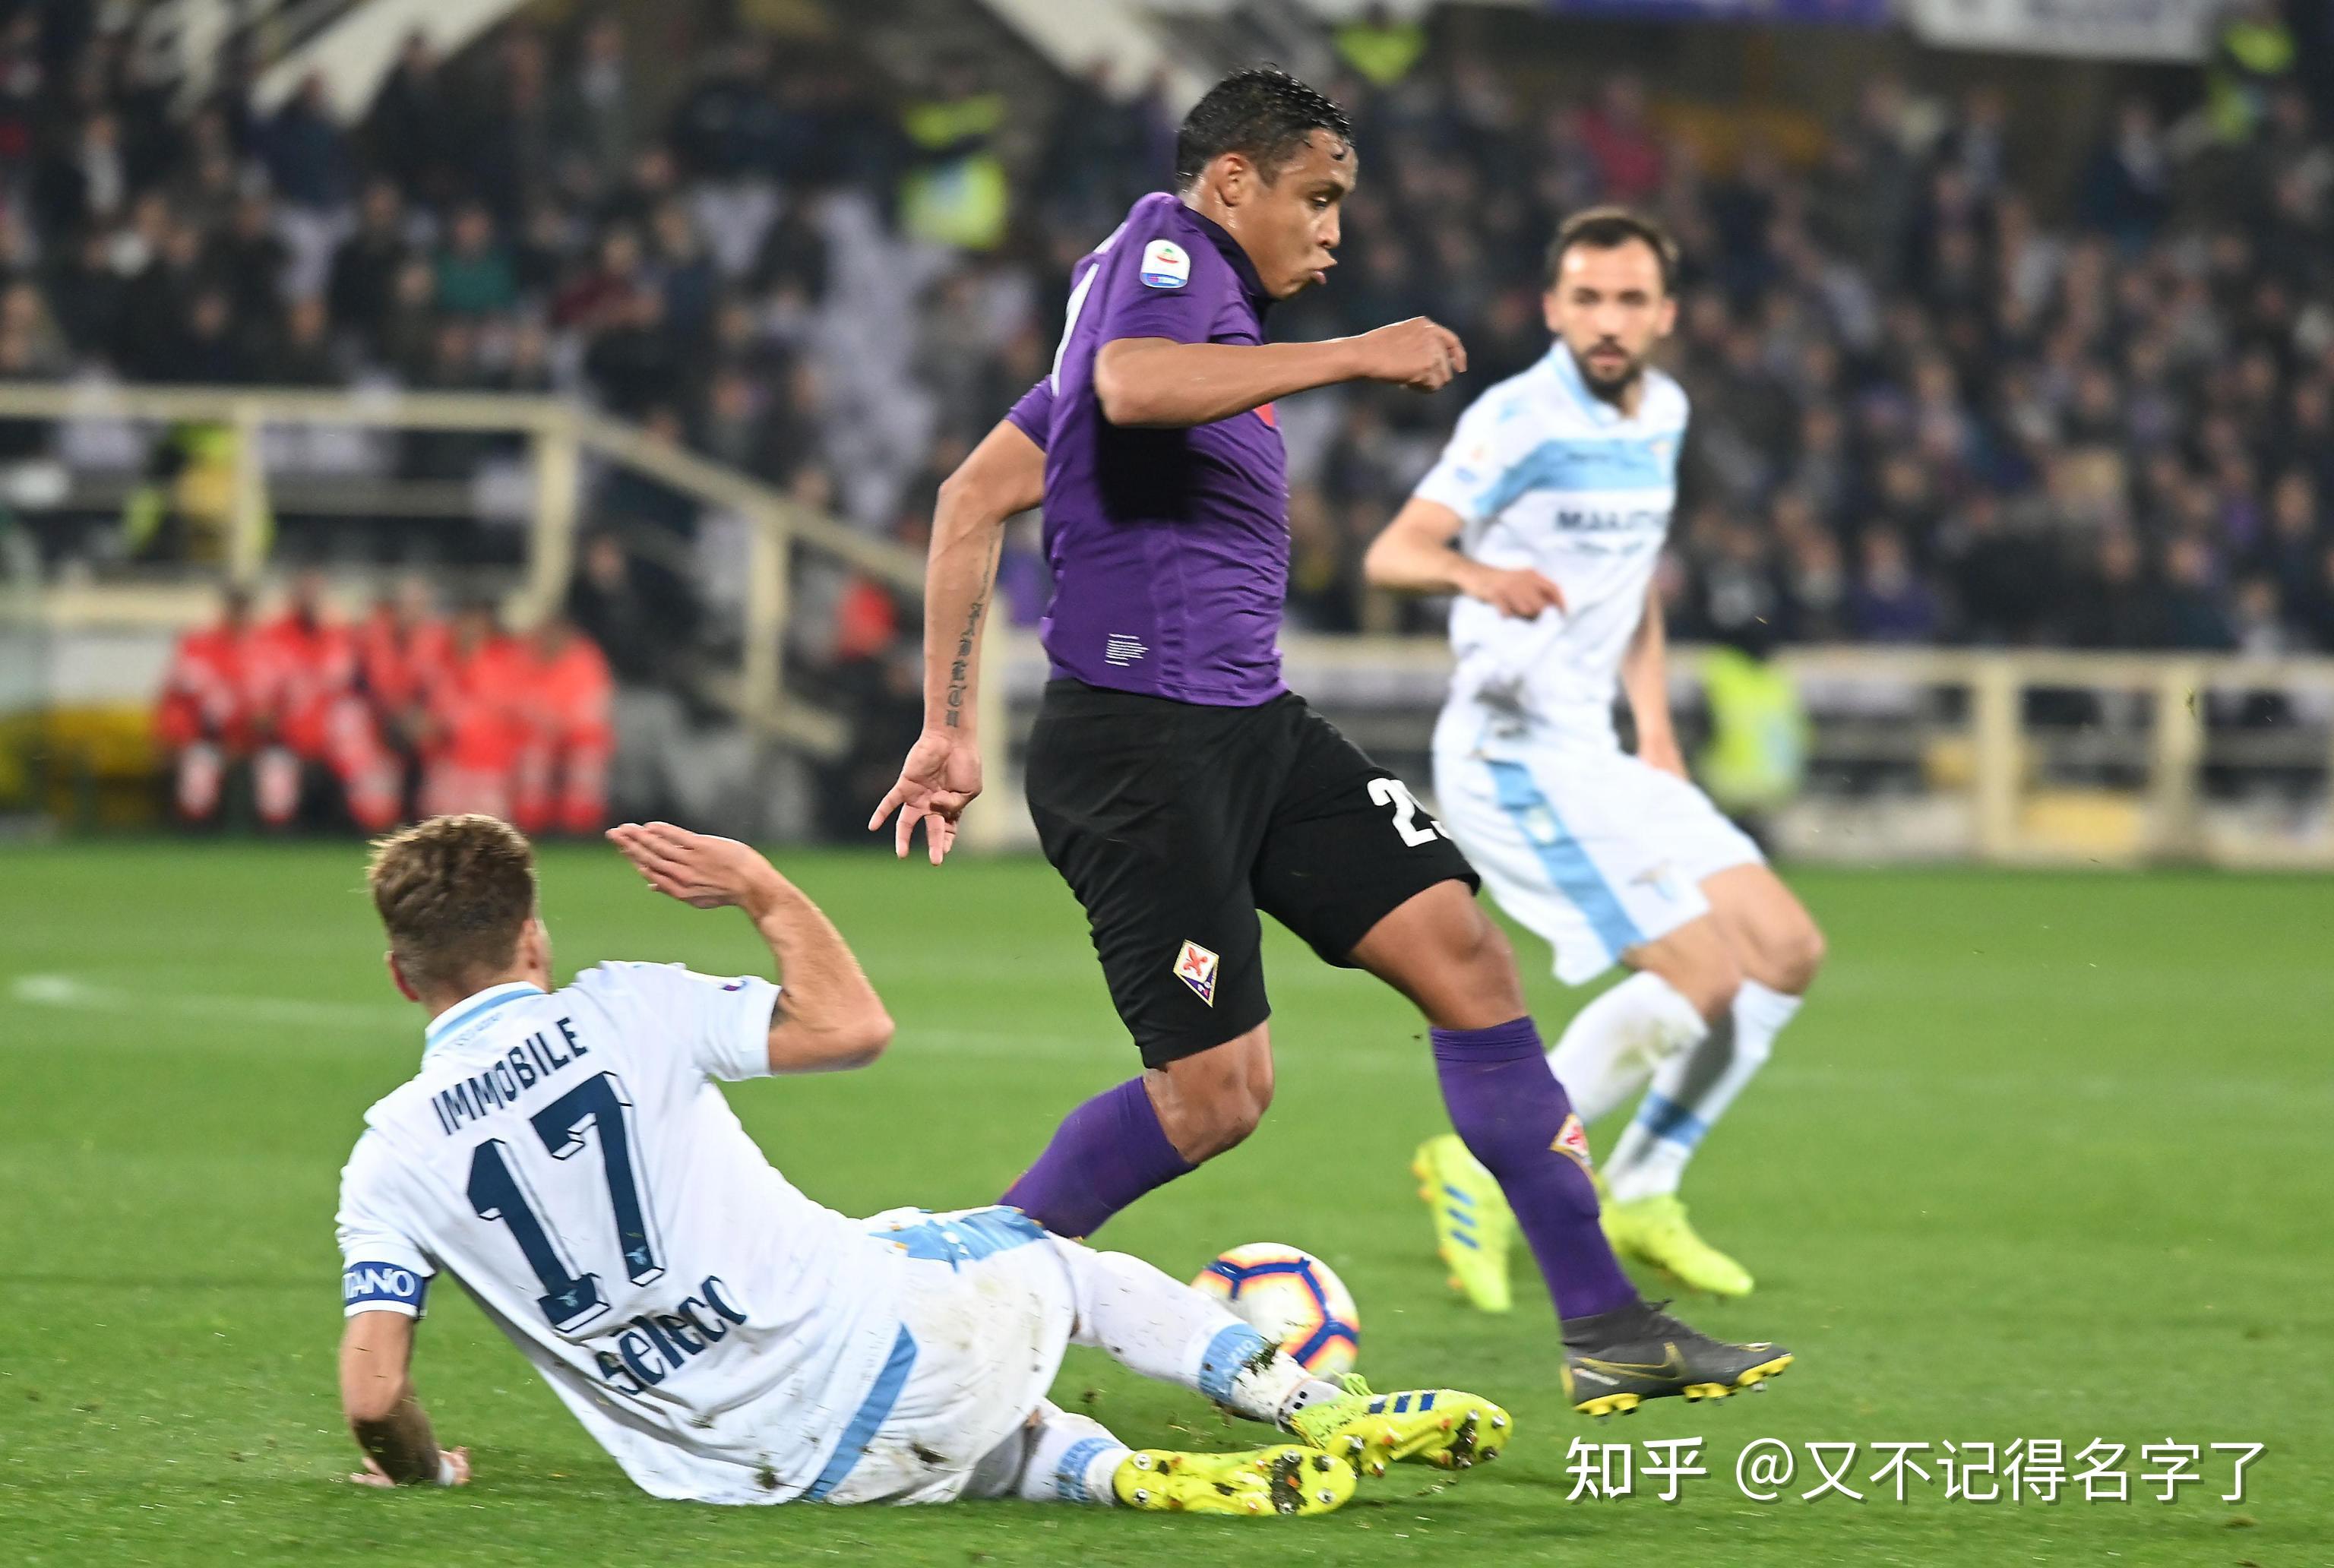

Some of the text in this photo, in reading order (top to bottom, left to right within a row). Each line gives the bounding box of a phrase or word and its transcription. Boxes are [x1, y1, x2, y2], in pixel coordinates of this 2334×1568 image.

[1367, 777, 1453, 848] 2
[432, 1016, 590, 1136] IMMOBILE
[466, 1070, 666, 1334] 17
